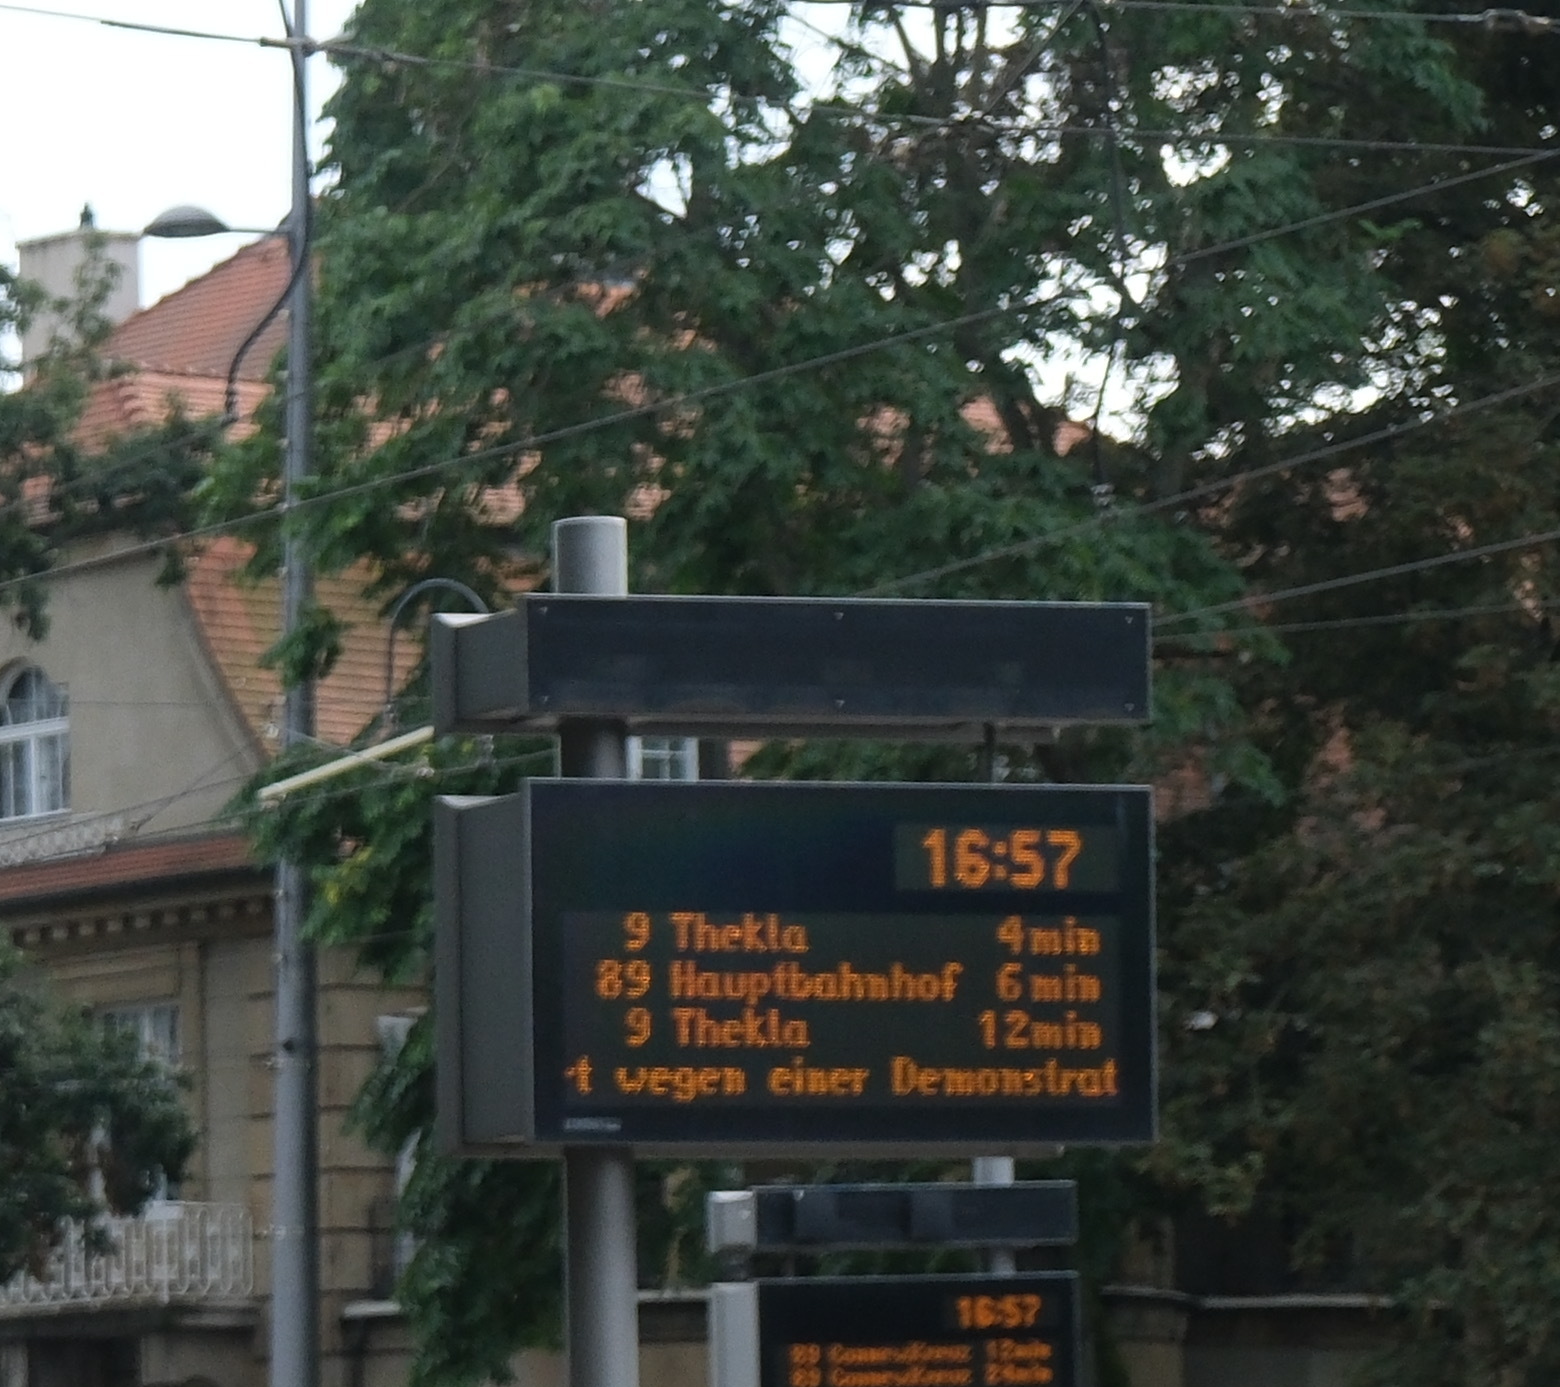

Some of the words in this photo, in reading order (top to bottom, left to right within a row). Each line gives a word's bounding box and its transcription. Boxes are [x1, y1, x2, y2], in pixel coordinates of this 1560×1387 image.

[922, 827, 1082, 889] 16:57
[623, 911, 651, 953] 9
[669, 911, 809, 953] Thekla
[594, 958, 652, 1001] 89
[669, 960, 965, 1007] Hauptbahnhof
[624, 1006, 652, 1049] 9
[672, 1006, 811, 1049] Thekla
[615, 1064, 747, 1102] wegen
[767, 1056, 871, 1097] einer
[889, 1055, 1119, 1098] Demonstrat
[957, 1294, 1042, 1329] 16:57
